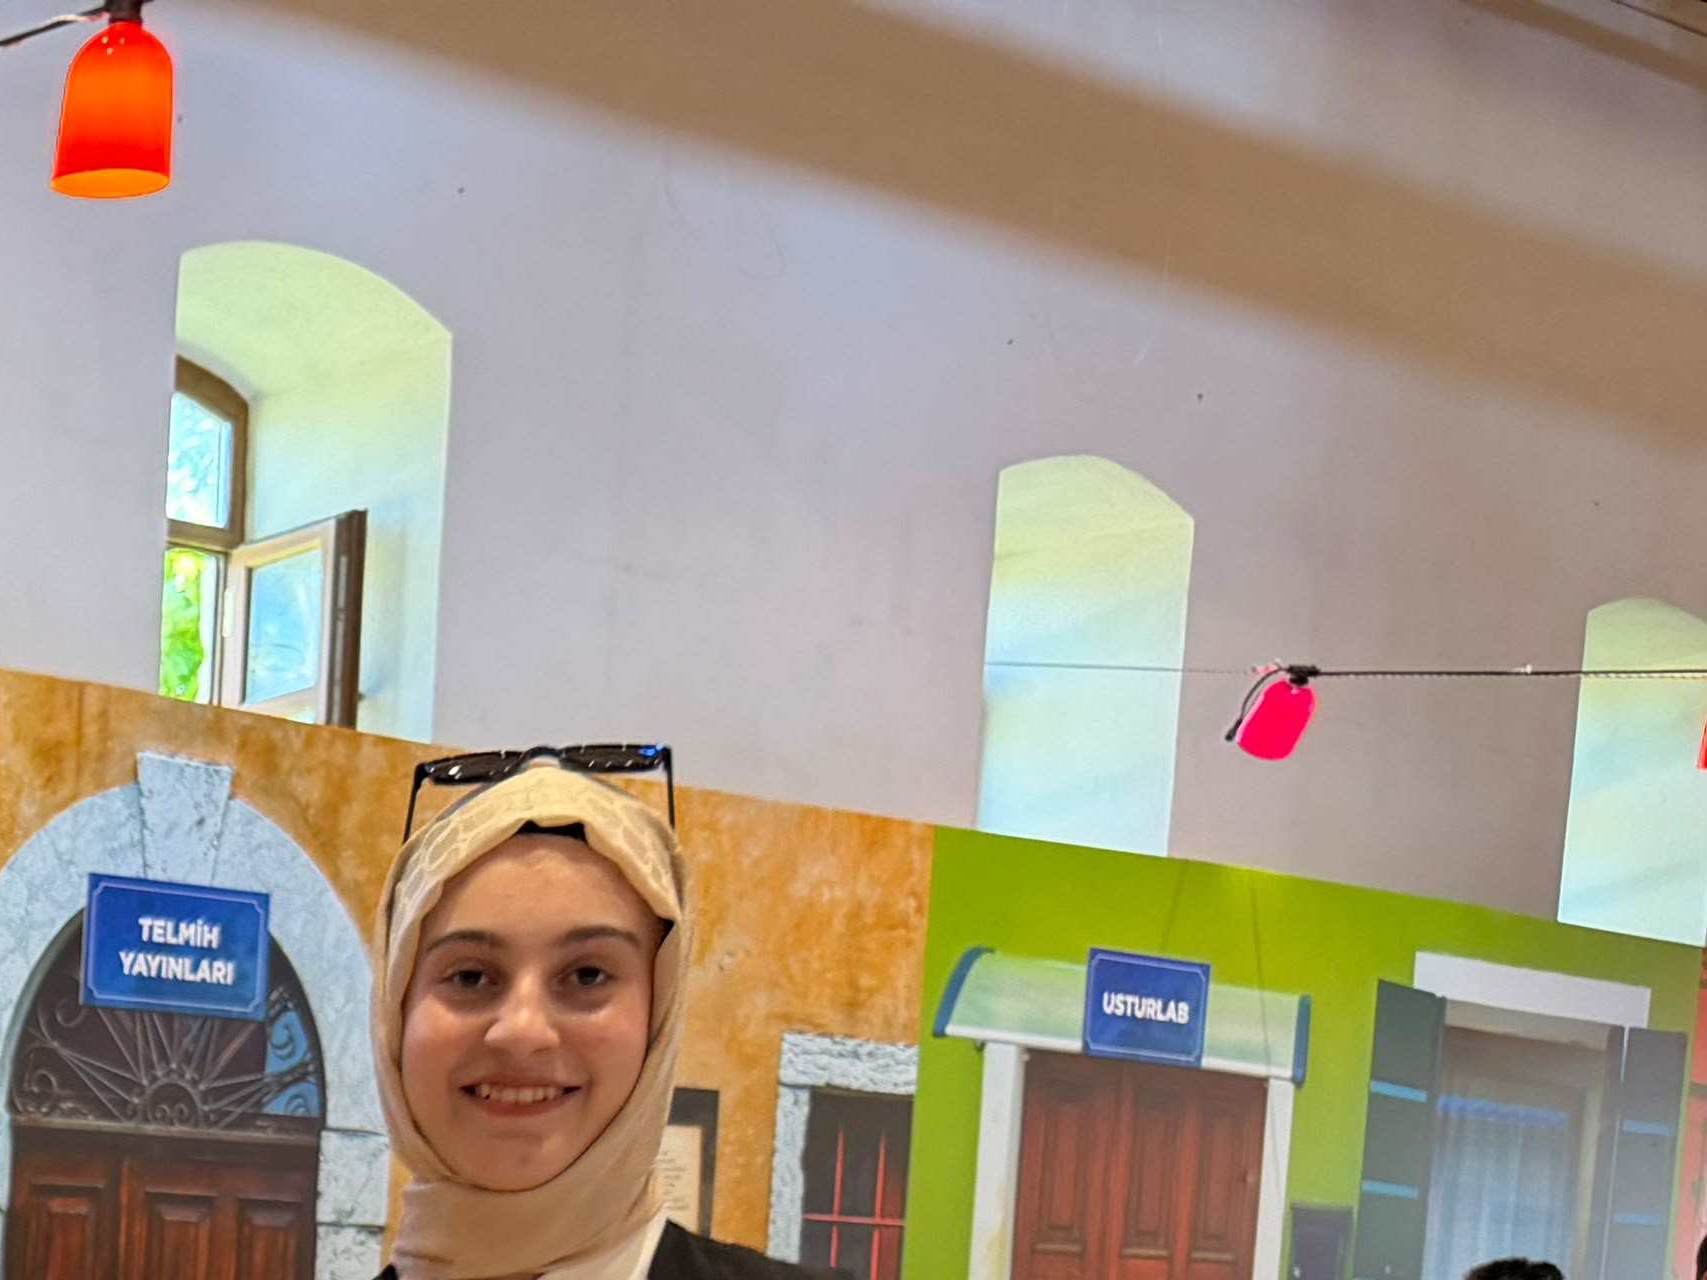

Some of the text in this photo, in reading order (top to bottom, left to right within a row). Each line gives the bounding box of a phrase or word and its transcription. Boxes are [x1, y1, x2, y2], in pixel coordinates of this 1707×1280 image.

[138, 917, 221, 949] TELMİH
[119, 951, 235, 985] YAYINLARI
[1102, 991, 1190, 1024] USTURLAB
